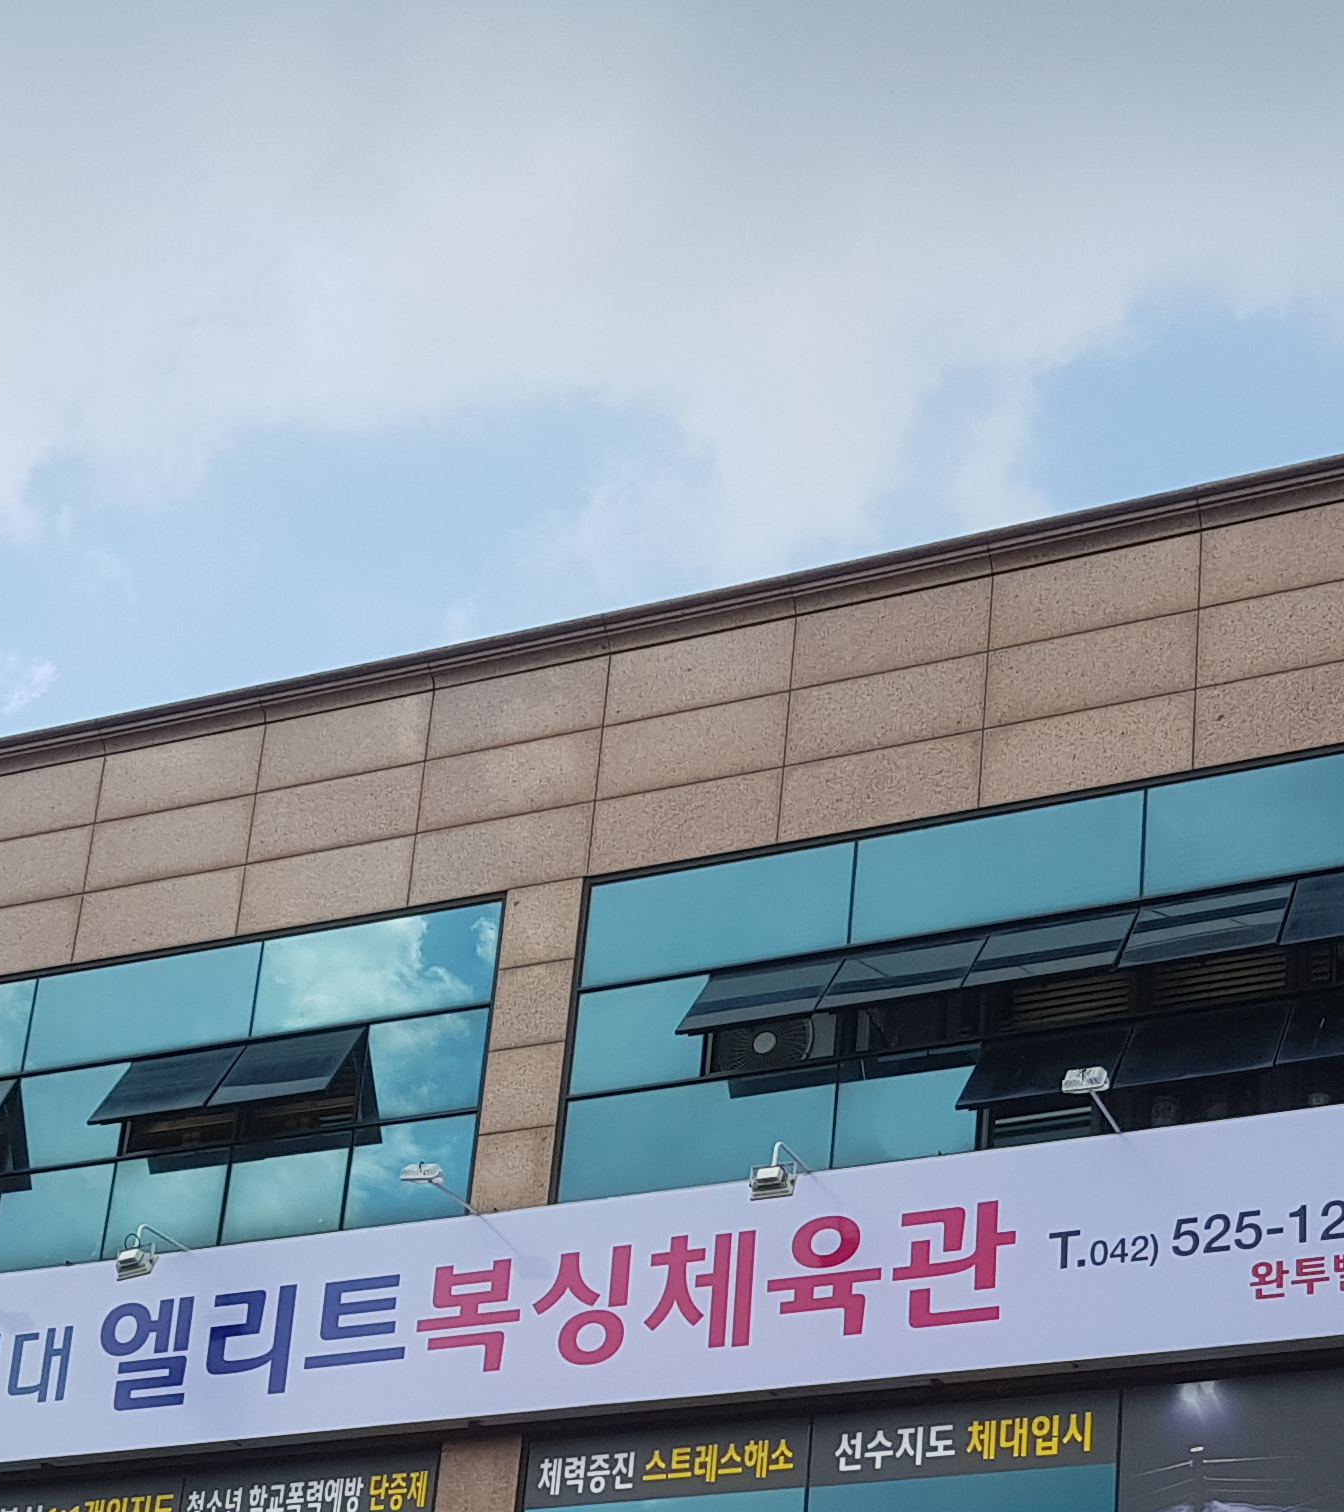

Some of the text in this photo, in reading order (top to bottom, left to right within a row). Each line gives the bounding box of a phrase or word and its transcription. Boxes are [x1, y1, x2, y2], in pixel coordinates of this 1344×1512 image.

[537, 1438, 795, 1497] 체력증진 스트레스해소
[833, 1411, 1094, 1472] 선수지도 체대입시
